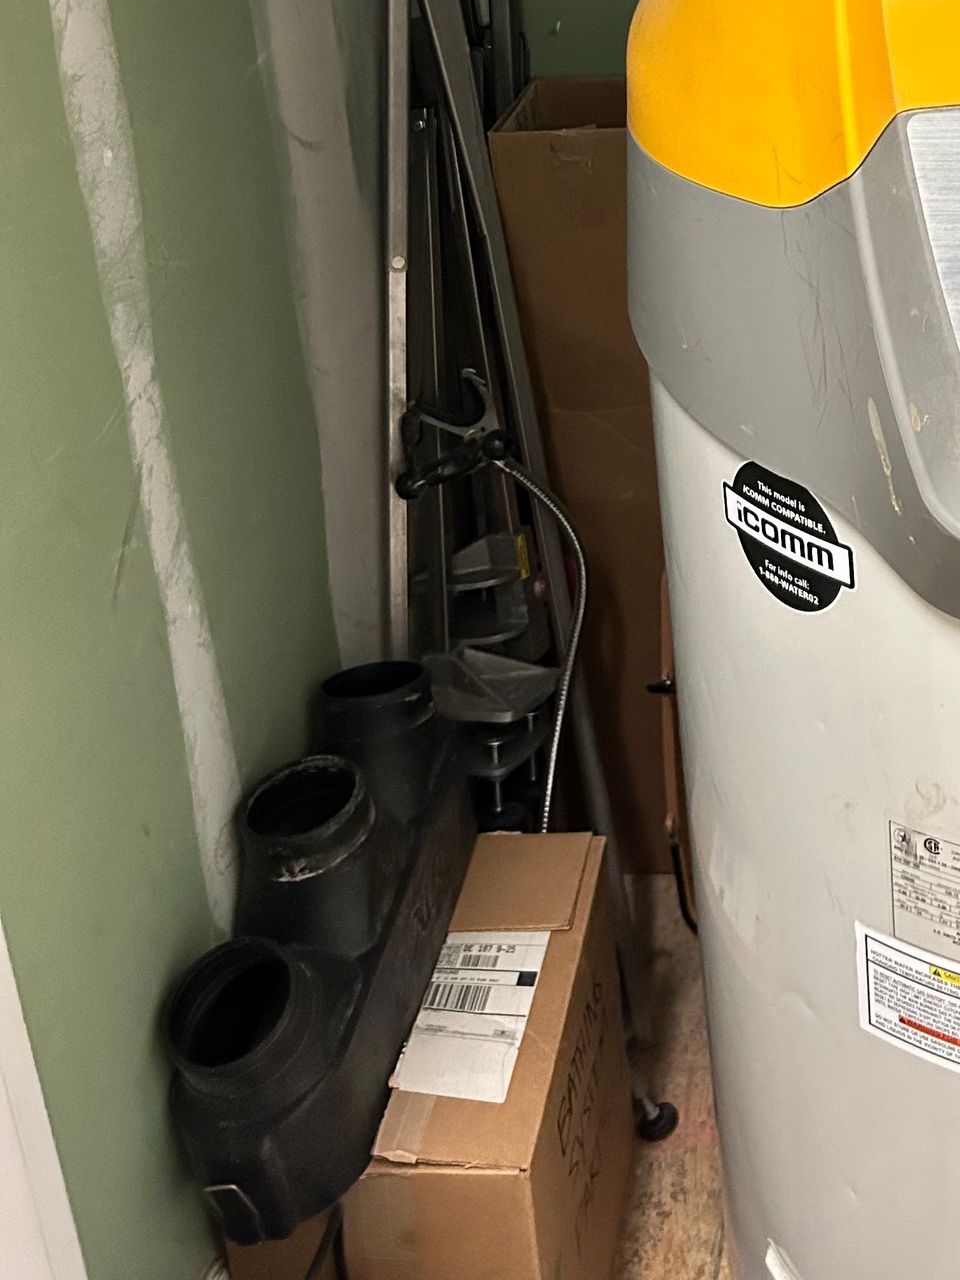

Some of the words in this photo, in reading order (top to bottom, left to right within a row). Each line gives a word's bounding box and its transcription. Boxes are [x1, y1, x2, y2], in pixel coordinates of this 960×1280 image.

[757, 481, 772, 495] This
[774, 491, 796, 508] model
[799, 502, 805, 512] is
[765, 559, 776, 572] For
[778, 566, 793, 580] info
[794, 576, 809, 589] call:
